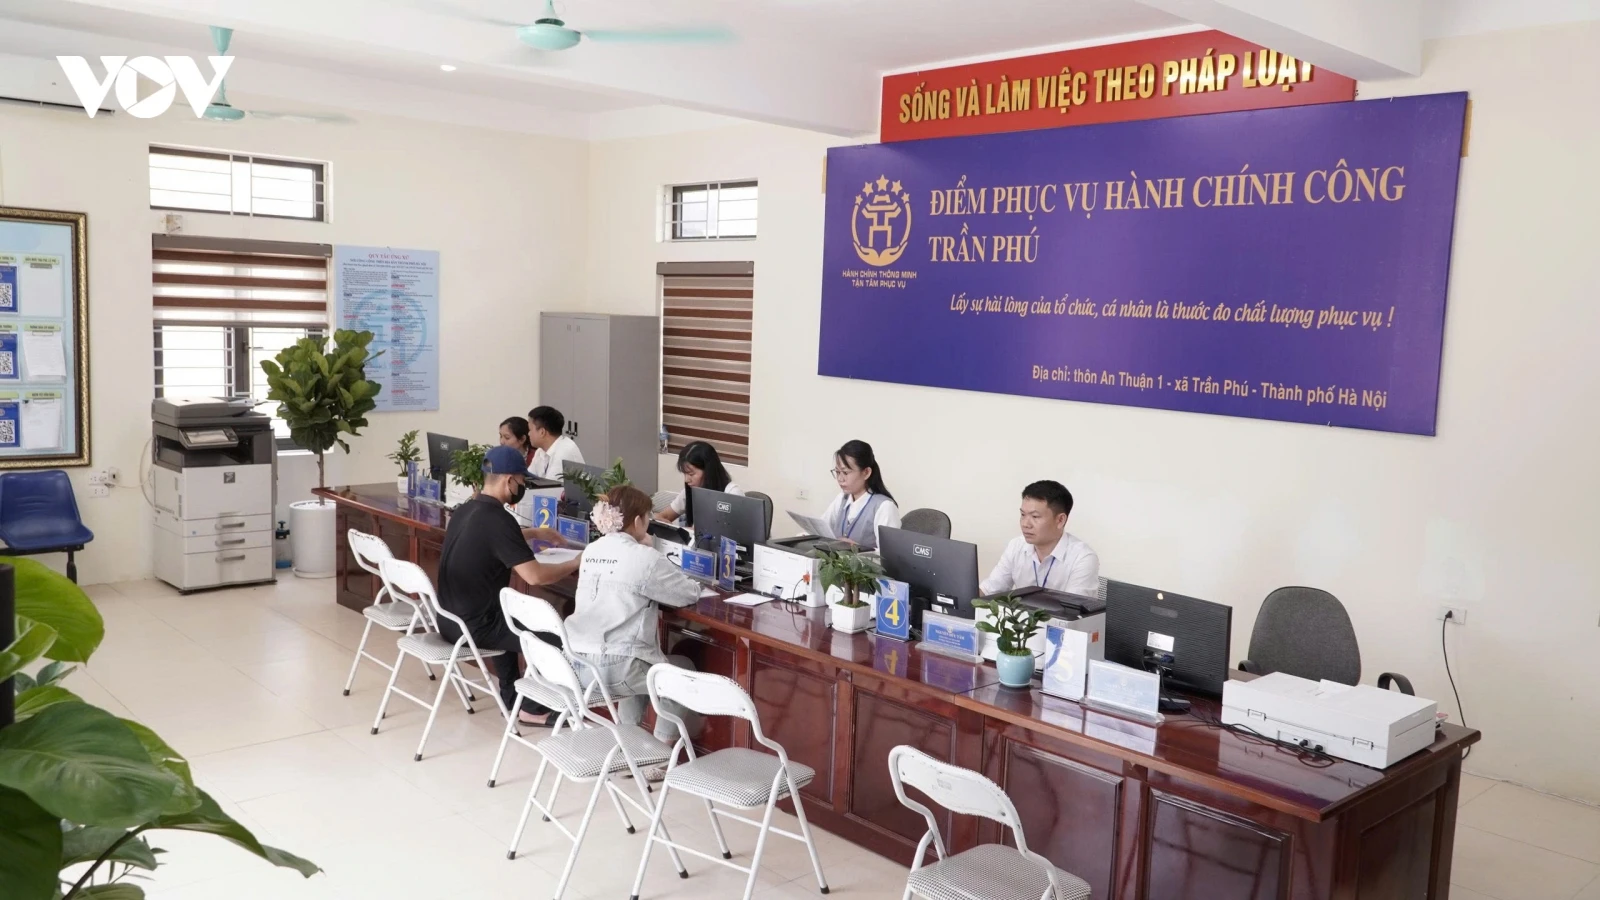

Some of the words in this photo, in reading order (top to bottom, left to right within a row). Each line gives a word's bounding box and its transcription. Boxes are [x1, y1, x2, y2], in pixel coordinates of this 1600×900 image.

[899, 83, 950, 124] SỐNG
[956, 79, 980, 117] VÀ
[986, 75, 1030, 115] LÀM
[1036, 67, 1087, 114] VIỆC
[1094, 63, 1154, 103] THEO
[1162, 49, 1235, 96] PHÁP
[930, 174, 987, 216] ĐIỂM
[992, 184, 1057, 221] PHỤC
[1063, 181, 1099, 219] VỤ
[1104, 170, 1186, 210] HÀNH
[1192, 163, 1296, 208] CHÍNH
[1303, 158, 1406, 204] CÔNG
[928, 222, 987, 263] TRẦN
[992, 226, 1040, 263] PHÚ
[842, 268, 858, 277] HÀNH
[860, 269, 877, 278] CHÍNH
[879, 269, 900, 278] THÔNG
[901, 271, 917, 279] MINH
[880, 280, 895, 289] PHỤC
[897, 281, 906, 289] VỤ
[950, 292, 969, 315] Lấy
[970, 298, 984, 315] sự
[985, 296, 1002, 312] hài
[1004, 296, 1028, 317] lòng
[1031, 296, 1051, 314] của
[1054, 294, 1068, 314] tổ
[1068, 298, 1098, 318] chức,
[1102, 299, 1117, 317] cá
[1119, 300, 1152, 318] nhân
[1156, 300, 1169, 319] là
[1172, 301, 1210, 320] thước
[1213, 303, 1231, 321] đo
[1234, 300, 1267, 322] chất
[1270, 304, 1314, 328] lượng
[1317, 306, 1358, 330] phục
[1362, 310, 1382, 331] vụ
[1032, 365, 1049, 382] Địa
[1052, 366, 1070, 382] chỉ:
[1074, 369, 1097, 384] thôn
[1100, 370, 1115, 386] An
[1119, 372, 1154, 391] Thuận
[1157, 375, 1163, 389] 1
[1174, 377, 1189, 392] xã
[1192, 376, 1220, 394] Trần
[1224, 379, 1249, 397] Phú
[1261, 382, 1302, 401] Thành
[1307, 385, 1336, 406] phố
[1338, 388, 1357, 406] Hà
[1362, 390, 1387, 411] Nội
[539, 509, 550, 528] 2
[717, 502, 729, 511] CMS
[914, 546, 930, 556] CMS
[723, 555, 731, 579] 3
[885, 599, 900, 626] 4
